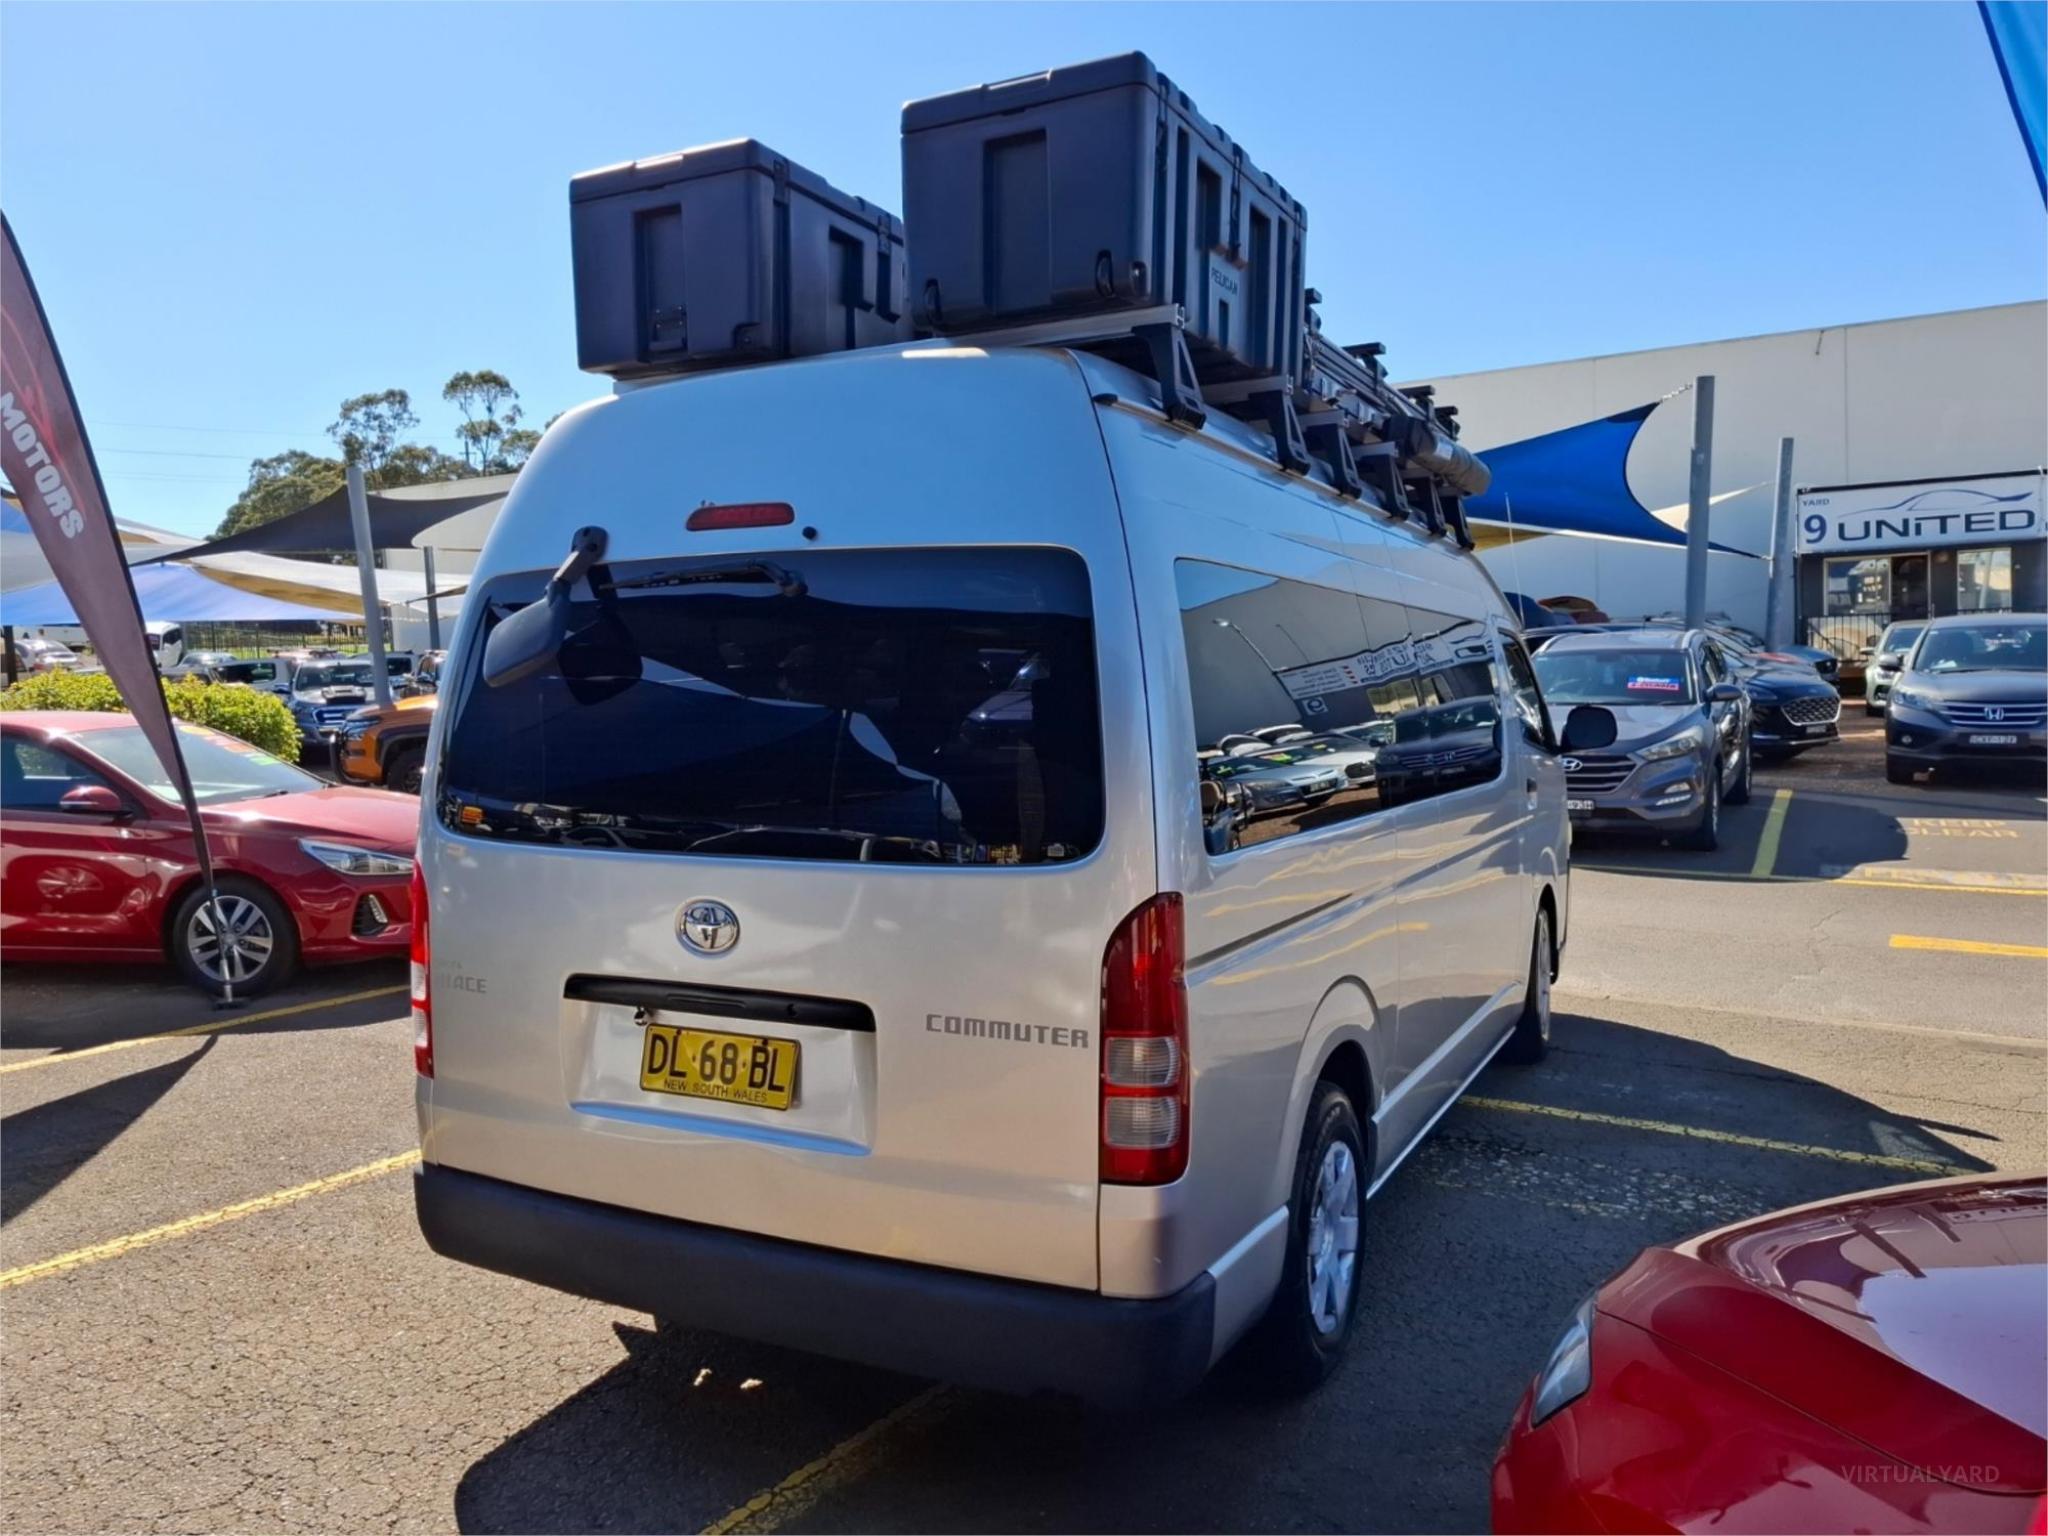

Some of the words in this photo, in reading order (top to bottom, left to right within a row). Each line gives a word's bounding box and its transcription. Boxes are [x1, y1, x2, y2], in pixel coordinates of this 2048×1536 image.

[0, 391, 85, 539] MOTORS
[1802, 498, 1830, 507] YARD
[1803, 514, 1828, 544] 9
[926, 1014, 1089, 1049] COMMUTER
[664, 1079, 688, 1092] NEW
[692, 1082, 728, 1097] SOUTH
[733, 1088, 768, 1103] WALES
